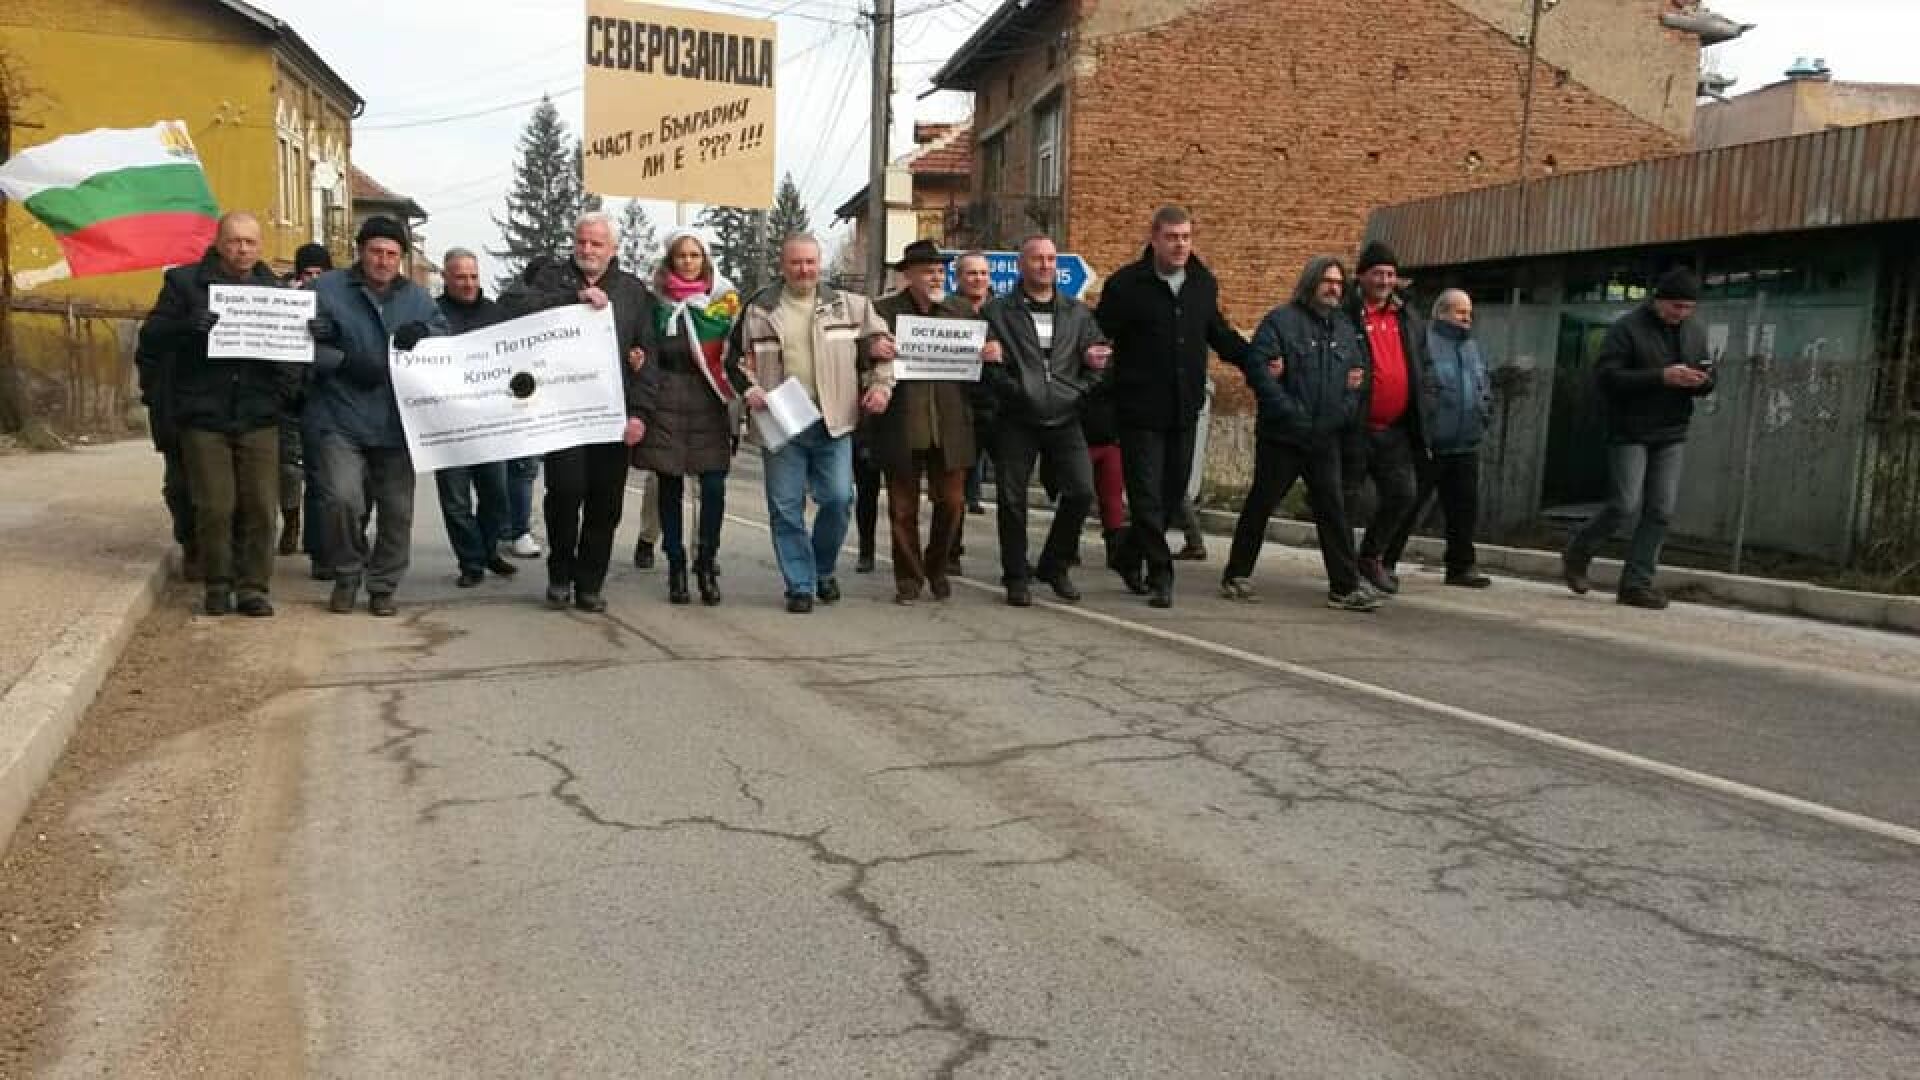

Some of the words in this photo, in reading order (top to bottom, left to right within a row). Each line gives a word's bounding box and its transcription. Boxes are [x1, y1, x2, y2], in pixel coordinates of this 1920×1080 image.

[586, 15, 773, 88] СЕВЕРОЗАПАДА
[641, 150, 665, 180] ЛИ
[673, 145, 685, 170] Е
[737, 122, 765, 151] !!!
[495, 326, 581, 356] Петрохан
[463, 366, 511, 385] Ключ
